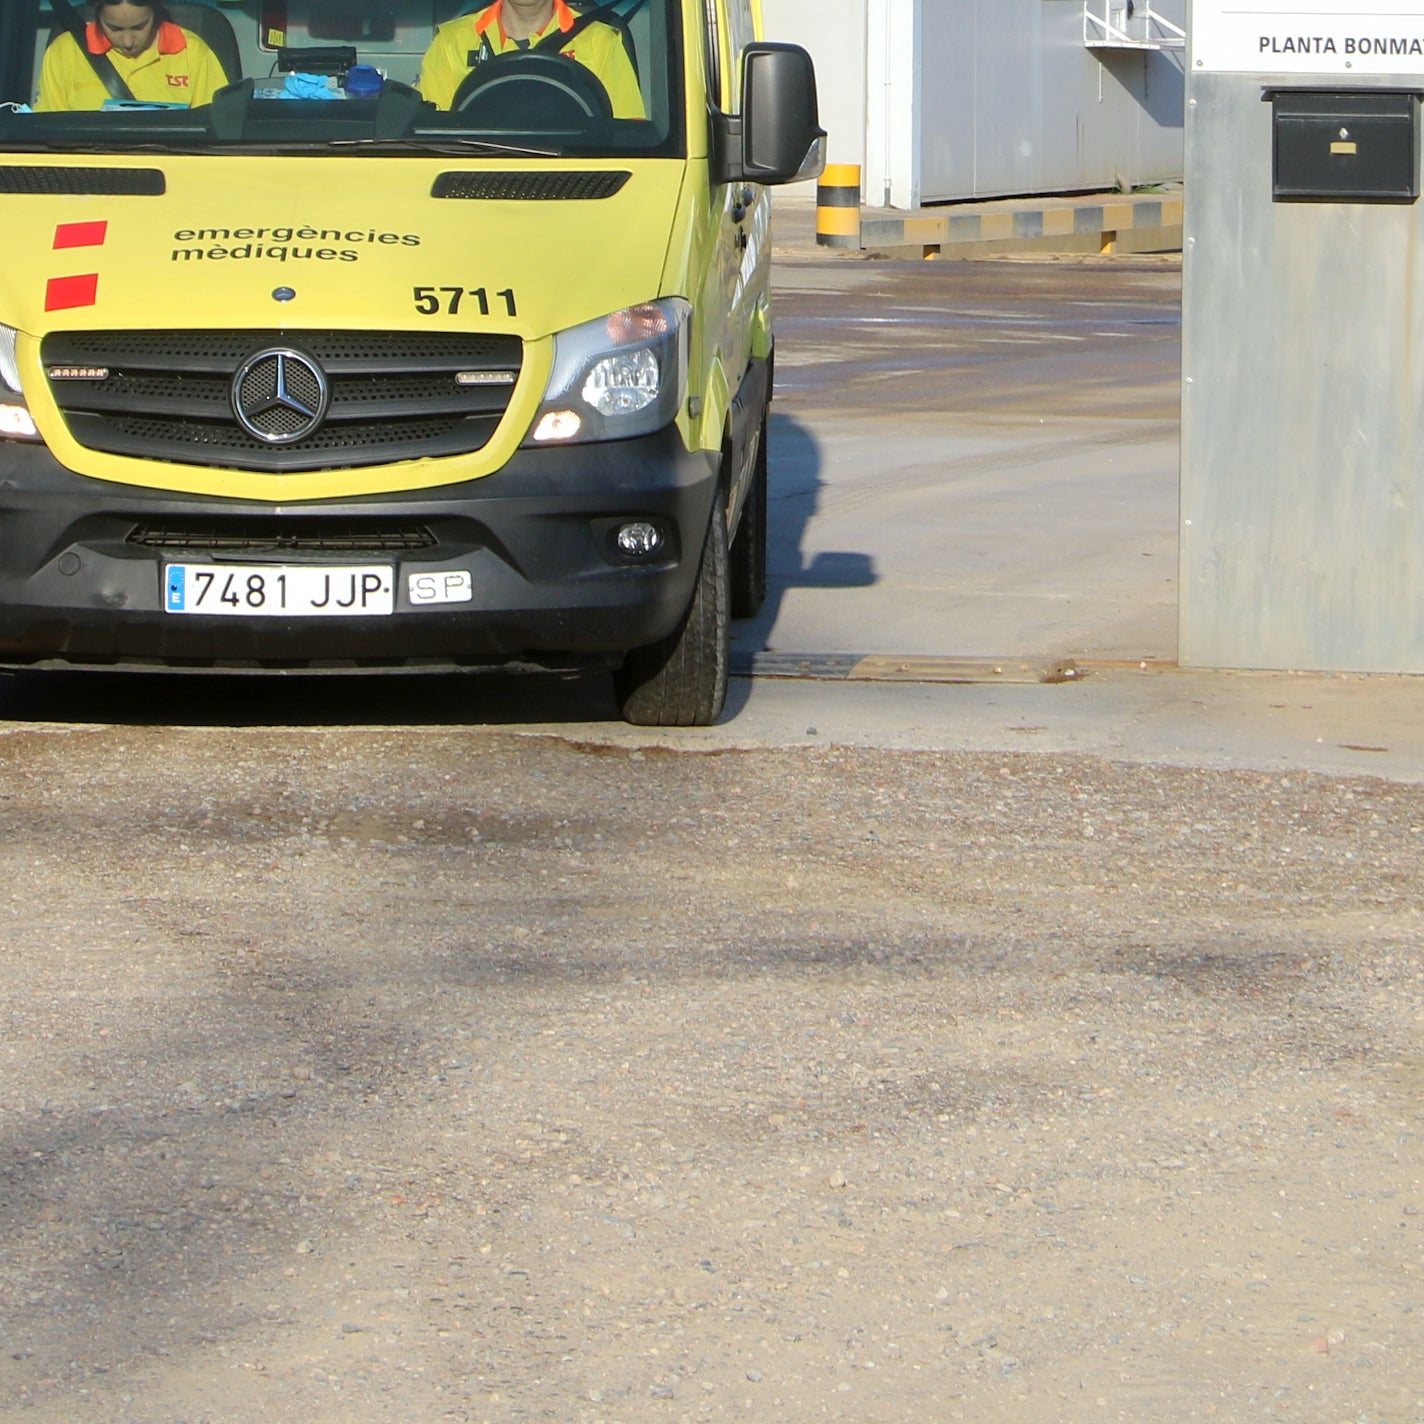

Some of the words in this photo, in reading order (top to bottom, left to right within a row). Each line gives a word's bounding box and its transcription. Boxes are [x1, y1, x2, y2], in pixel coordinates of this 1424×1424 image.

[1259, 36, 1337, 54] PLANTA
[173, 224, 422, 247] emergències
[170, 243, 359, 263] mèdiques
[413, 287, 518, 317] 5711
[171, 592, 182, 604] E
[194, 572, 287, 608] 7481
[310, 574, 383, 608] JJP
[416, 575, 465, 599] SP
